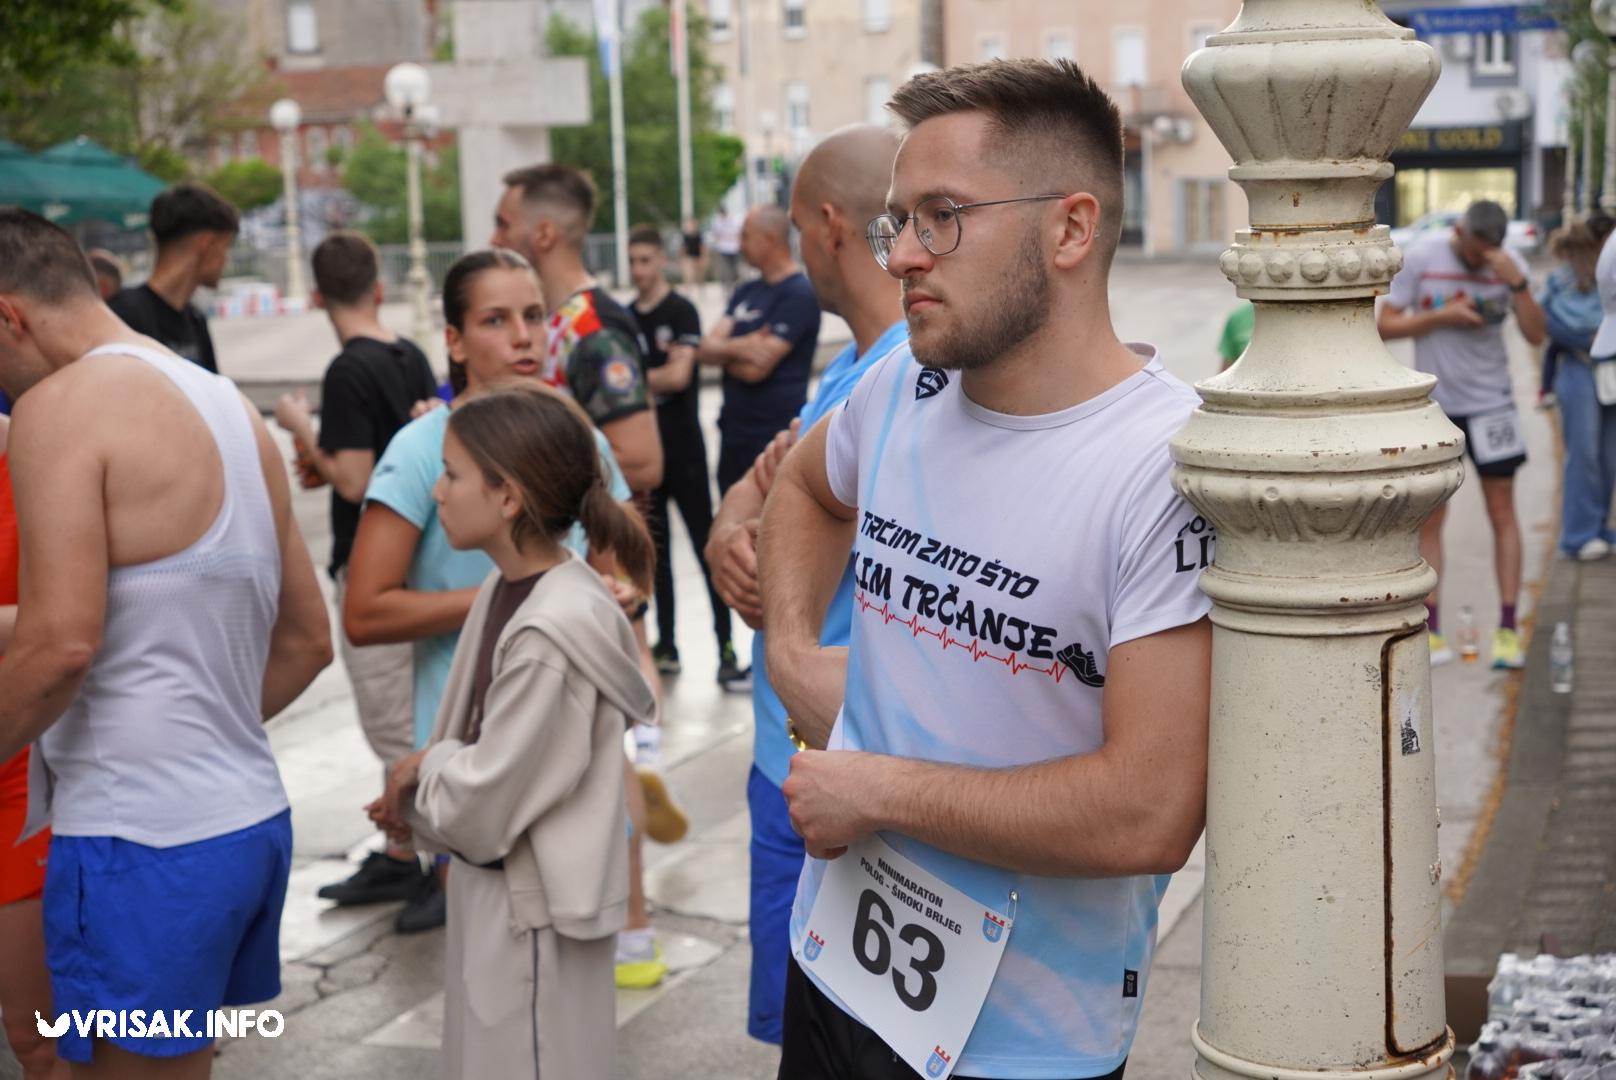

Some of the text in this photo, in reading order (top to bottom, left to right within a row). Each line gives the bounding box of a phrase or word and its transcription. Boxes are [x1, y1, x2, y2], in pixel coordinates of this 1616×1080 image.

[1435, 127, 1503, 150] GOLD
[861, 510, 1040, 600] TRČIM ZATO ŠTO
[1175, 535, 1216, 574] LI
[902, 574, 1058, 660] TRČANJE
[860, 856, 885, 886] POLOG
[891, 884, 923, 913] ŠIROKI
[925, 907, 962, 936] BRIJEG
[877, 857, 944, 908] MINIMARATON
[852, 888, 945, 1012] 63
